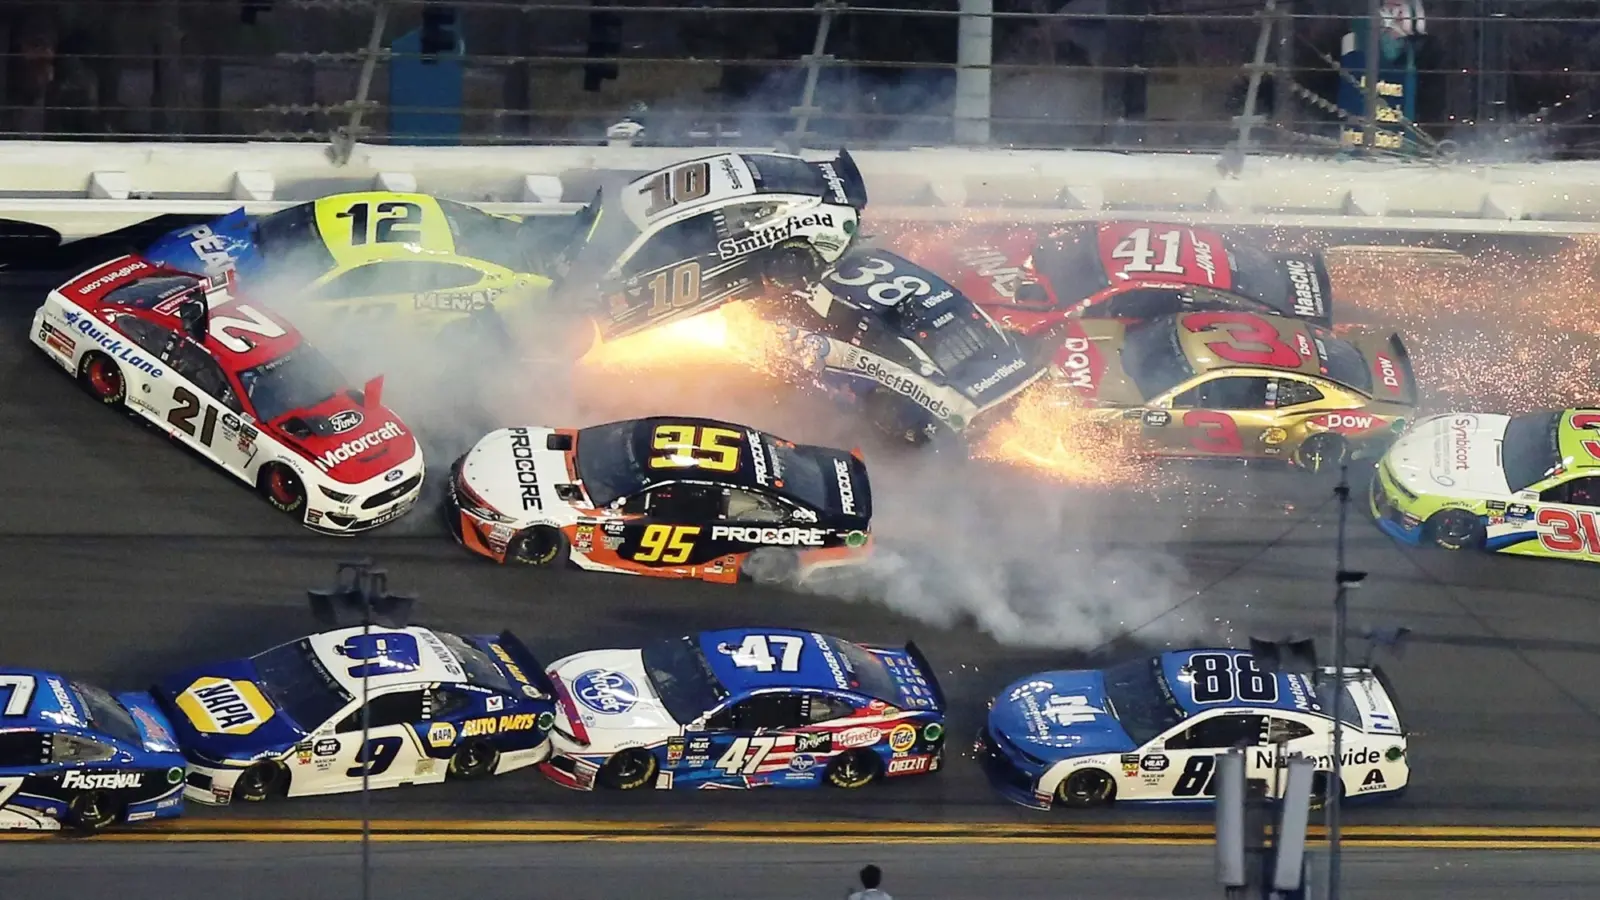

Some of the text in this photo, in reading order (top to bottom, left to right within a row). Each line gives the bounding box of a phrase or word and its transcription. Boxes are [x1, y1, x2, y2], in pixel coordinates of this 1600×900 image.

[639, 162, 711, 218] 10
[336, 203, 422, 247] 12
[717, 212, 834, 260] Smithfield
[1112, 228, 1184, 273] 41
[78, 260, 149, 296] FordParts.com
[648, 262, 701, 317] 10
[829, 257, 931, 307] 38
[1286, 259, 1315, 317] HaasCNC
[77, 317, 123, 355] Quick
[116, 346, 165, 380] Lane
[1181, 310, 1304, 369] 3
[856, 353, 951, 420] SelectBlinds
[970, 357, 1027, 395] SelectBlinds
[1383, 356, 1401, 388] DOW
[167, 385, 219, 448] 21
[332, 411, 361, 432] Ford
[1181, 409, 1244, 453] 3
[313, 420, 406, 474] Motorcraft
[650, 424, 742, 472] 95
[746, 430, 769, 487] PROCORE
[1452, 418, 1472, 471] Symbicort
[508, 427, 543, 512] PROCORE
[833, 458, 857, 515] PROCORE
[604, 523, 626, 534] HEAT
[634, 524, 701, 564] 95
[711, 525, 825, 546] PROCORE
[1537, 507, 1600, 556] 31
[344, 632, 421, 678] 9
[733, 634, 803, 672] 47
[810, 632, 849, 690] KROGER.COM
[1189, 653, 1280, 703] 88
[194, 683, 256, 729] NAPA
[461, 713, 537, 737] AUTO PARTS
[317, 743, 338, 753] HEAT
[432, 726, 453, 742] NAPA
[689, 741, 712, 750] HEAT
[715, 737, 776, 775] 47
[795, 734, 831, 752] Breyers
[892, 730, 914, 747] Tide
[346, 736, 404, 777] 9
[790, 755, 815, 770] Kroger
[1143, 759, 1165, 769] HEAT
[61, 769, 143, 790] FASTENAL
